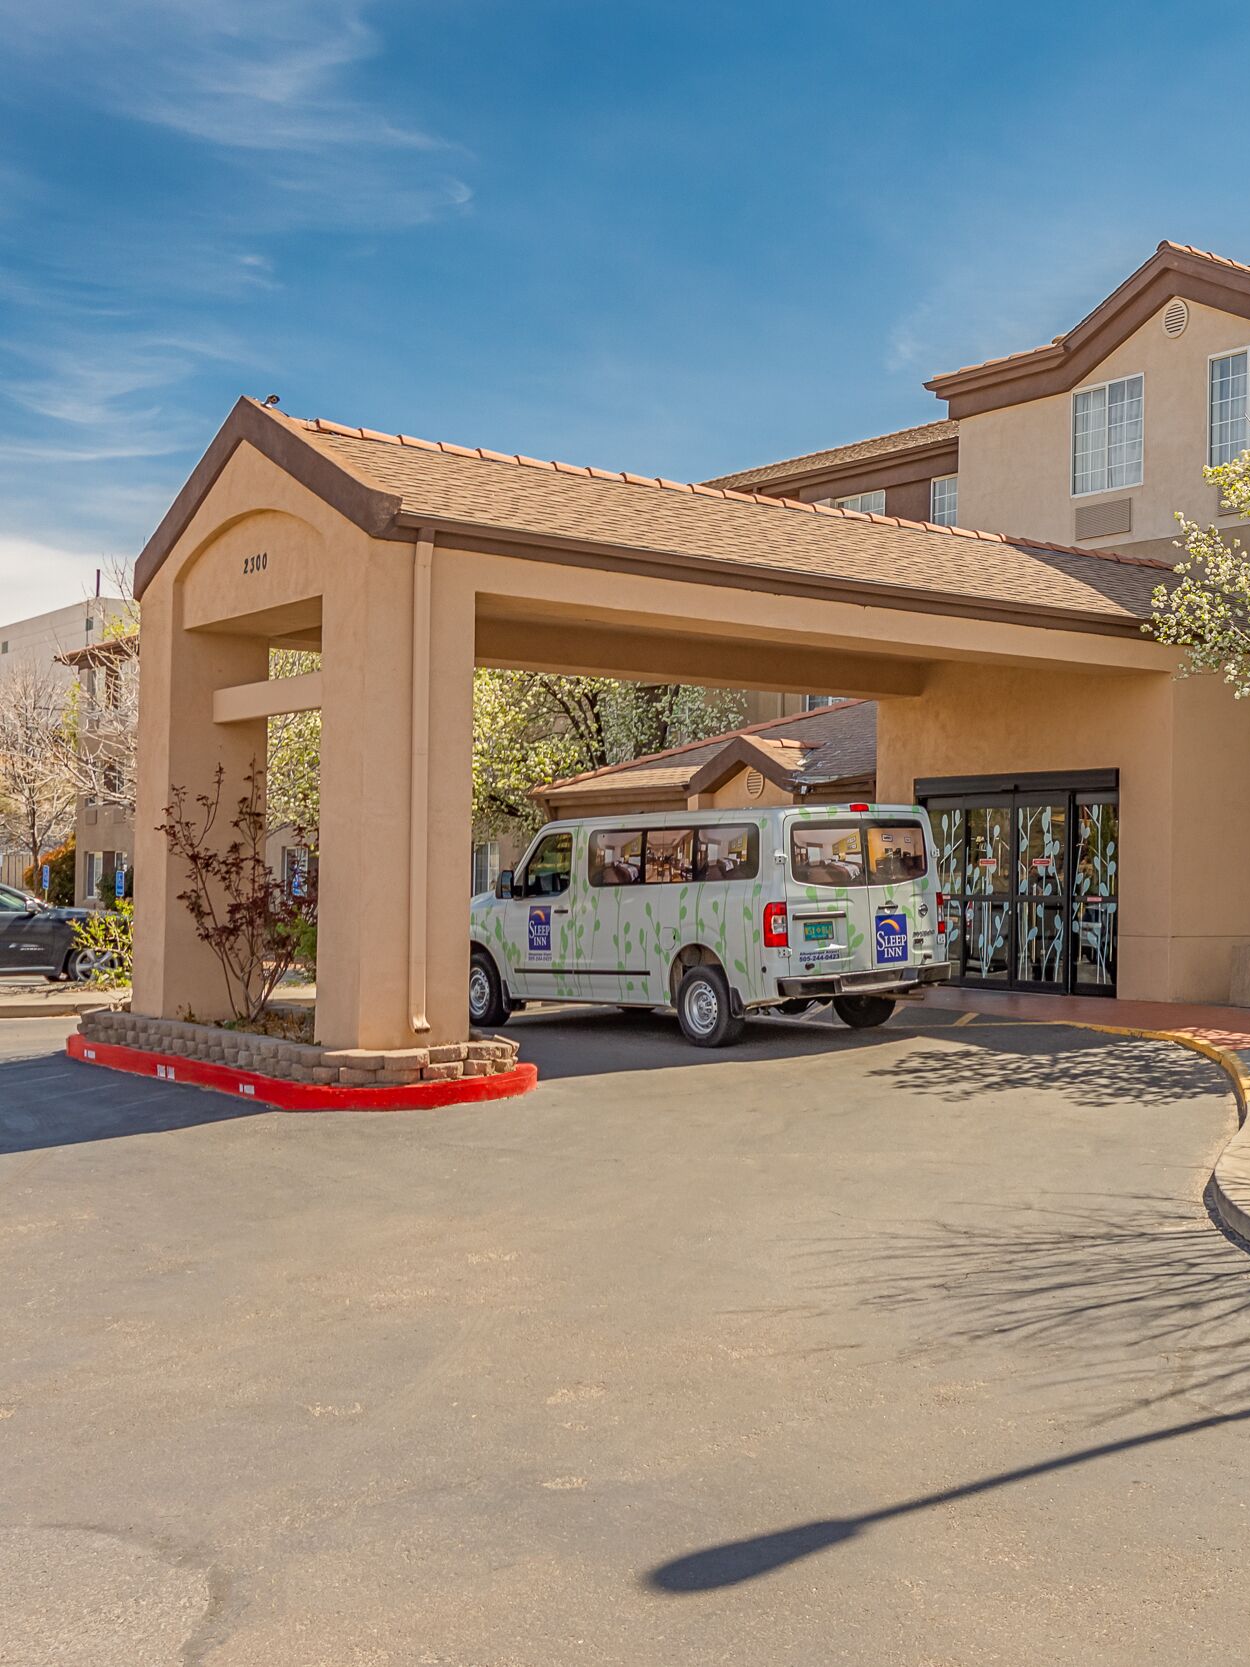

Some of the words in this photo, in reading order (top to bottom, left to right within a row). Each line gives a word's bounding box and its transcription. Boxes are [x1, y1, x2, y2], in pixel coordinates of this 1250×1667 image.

[244, 552, 268, 574] 2300
[529, 921, 550, 939] SLEEP
[534, 936, 547, 946] INN
[877, 931, 906, 950] SLEEP
[799, 954, 840, 962] 505-244-0423
[884, 947, 903, 958] INN
